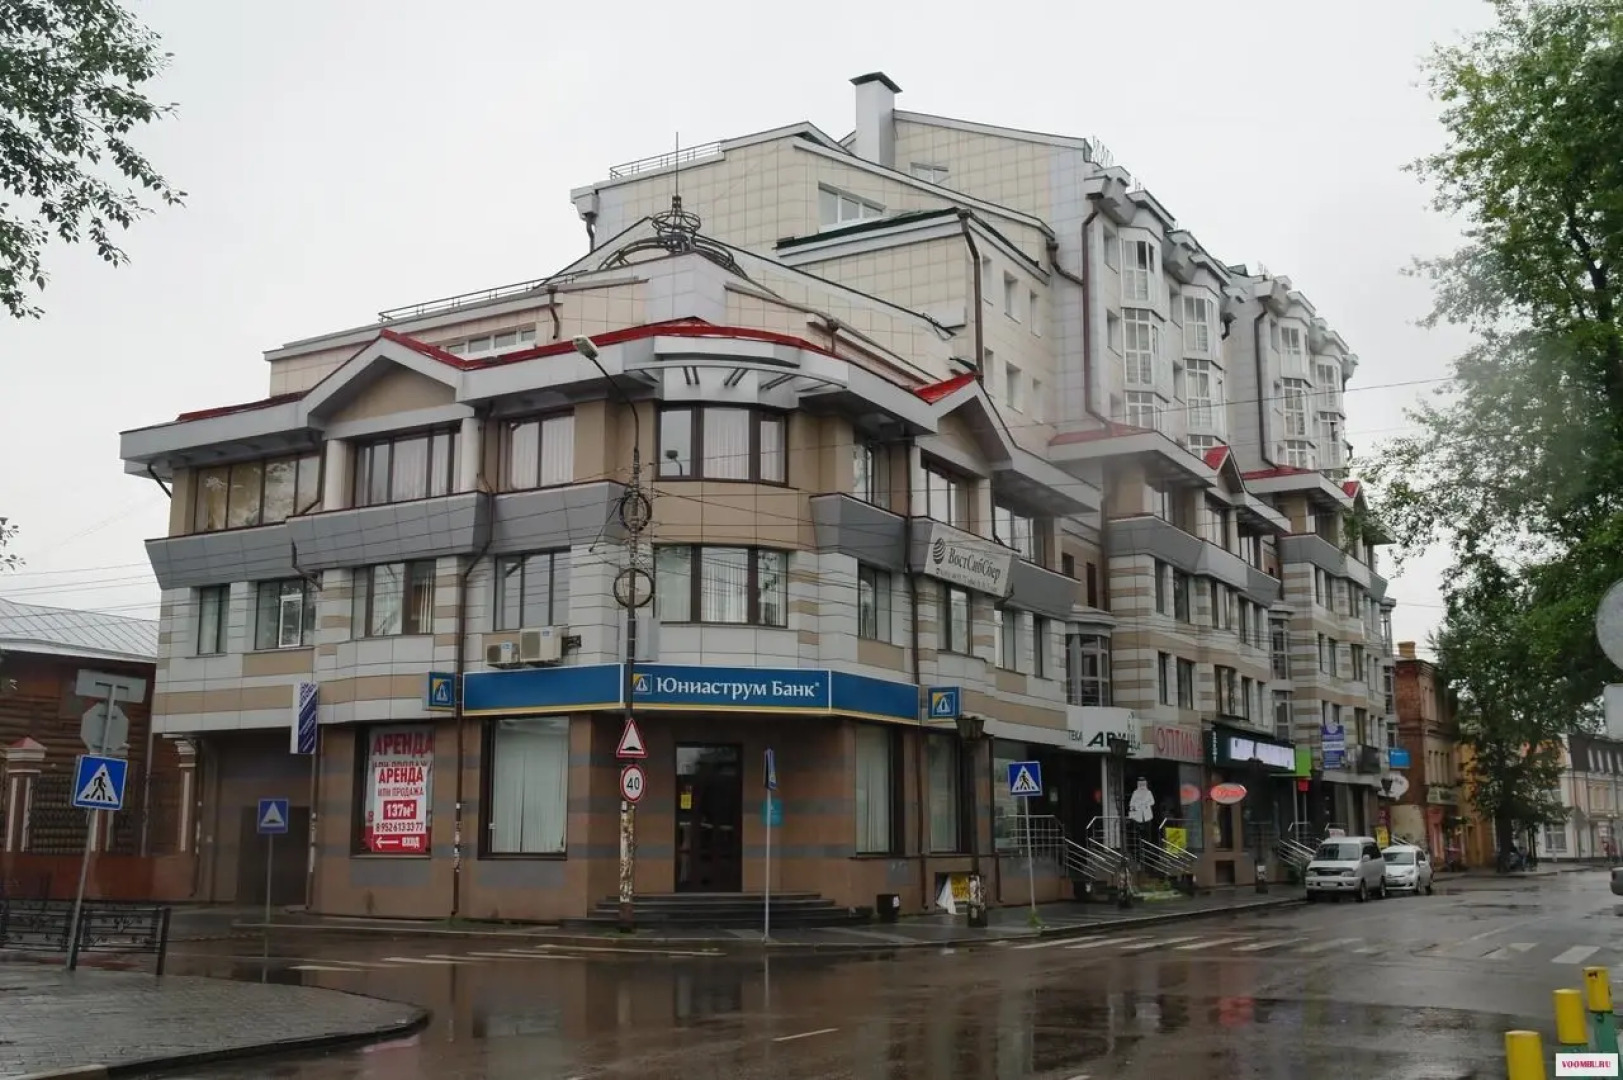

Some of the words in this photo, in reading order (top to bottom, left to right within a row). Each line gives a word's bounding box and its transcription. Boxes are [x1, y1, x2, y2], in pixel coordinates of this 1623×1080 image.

[656, 677, 767, 700] Юниаструм
[373, 733, 433, 757] АРЕНДА
[379, 767, 424, 785] АРЕНДА
[627, 777, 640, 790] 40
[377, 788, 391, 797] ИЛИ
[392, 787, 424, 798] ПРОДАЖА
